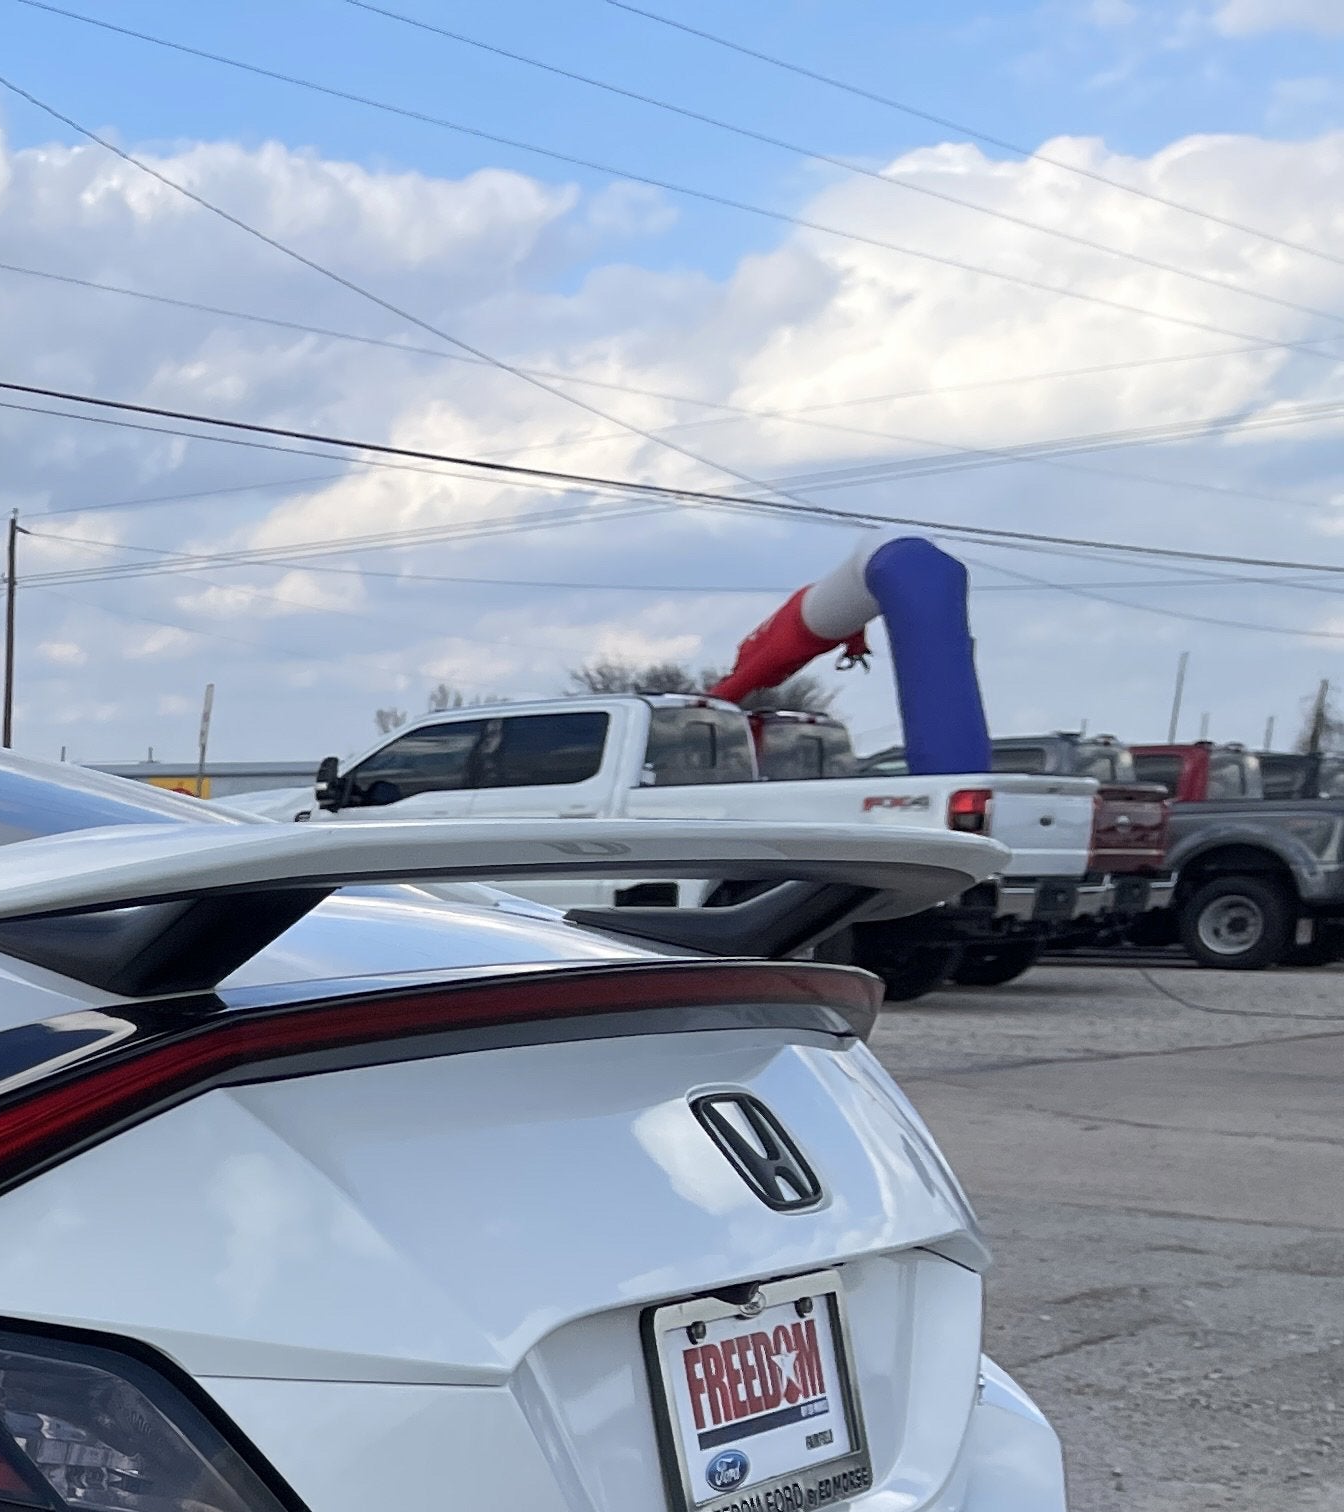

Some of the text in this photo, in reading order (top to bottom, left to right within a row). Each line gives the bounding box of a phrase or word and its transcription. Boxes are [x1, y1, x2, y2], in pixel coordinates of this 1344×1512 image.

[863, 796, 930, 812] FX4
[683, 1319, 826, 1430] FREEDOM
[819, 1476, 833, 1500] ED
[833, 1466, 870, 1495] MORSE
